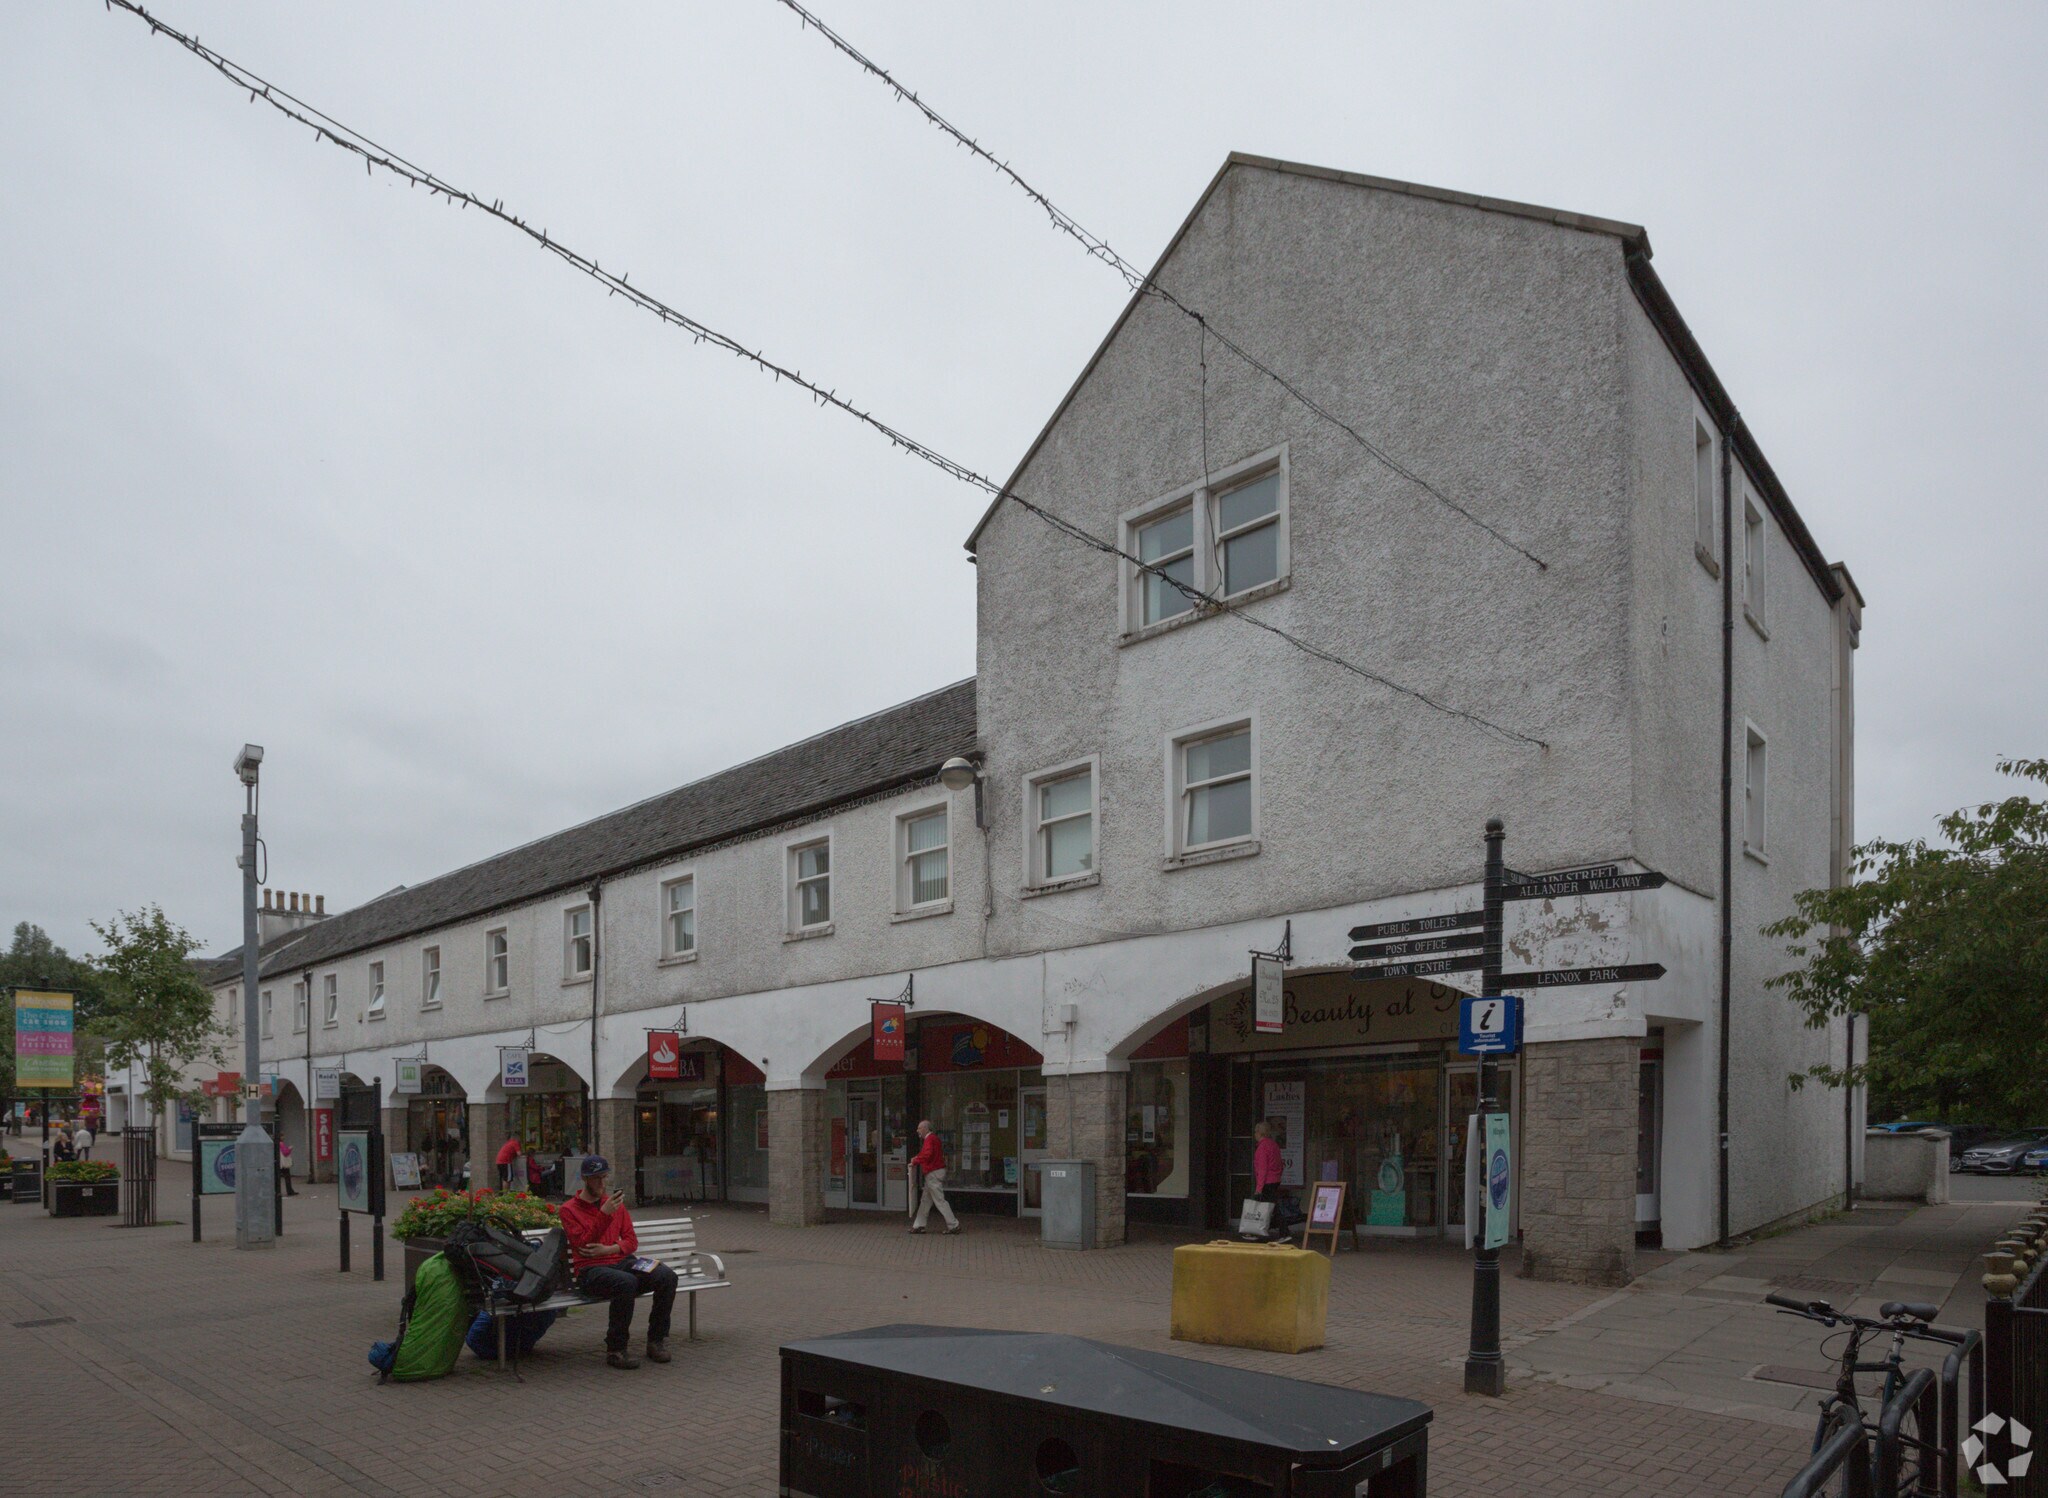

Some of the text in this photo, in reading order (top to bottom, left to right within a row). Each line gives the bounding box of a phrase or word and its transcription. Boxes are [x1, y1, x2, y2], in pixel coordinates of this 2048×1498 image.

[1566, 866, 1616, 881] STREET
[1519, 875, 1642, 897] ALLANDER WALKWAY
[1377, 916, 1457, 936] PUBLIC TOILETS
[1385, 939, 1447, 955] POST OFFICE
[1383, 960, 1452, 977] TOWN CENTRE
[1537, 968, 1619, 985] LENNOX PARK
[1282, 990, 1375, 1035] Beauty
[1385, 988, 1416, 1016] at
[651, 1064, 677, 1072] Santander
[248, 1086, 258, 1097] H
[319, 1114, 328, 1156] SALE
